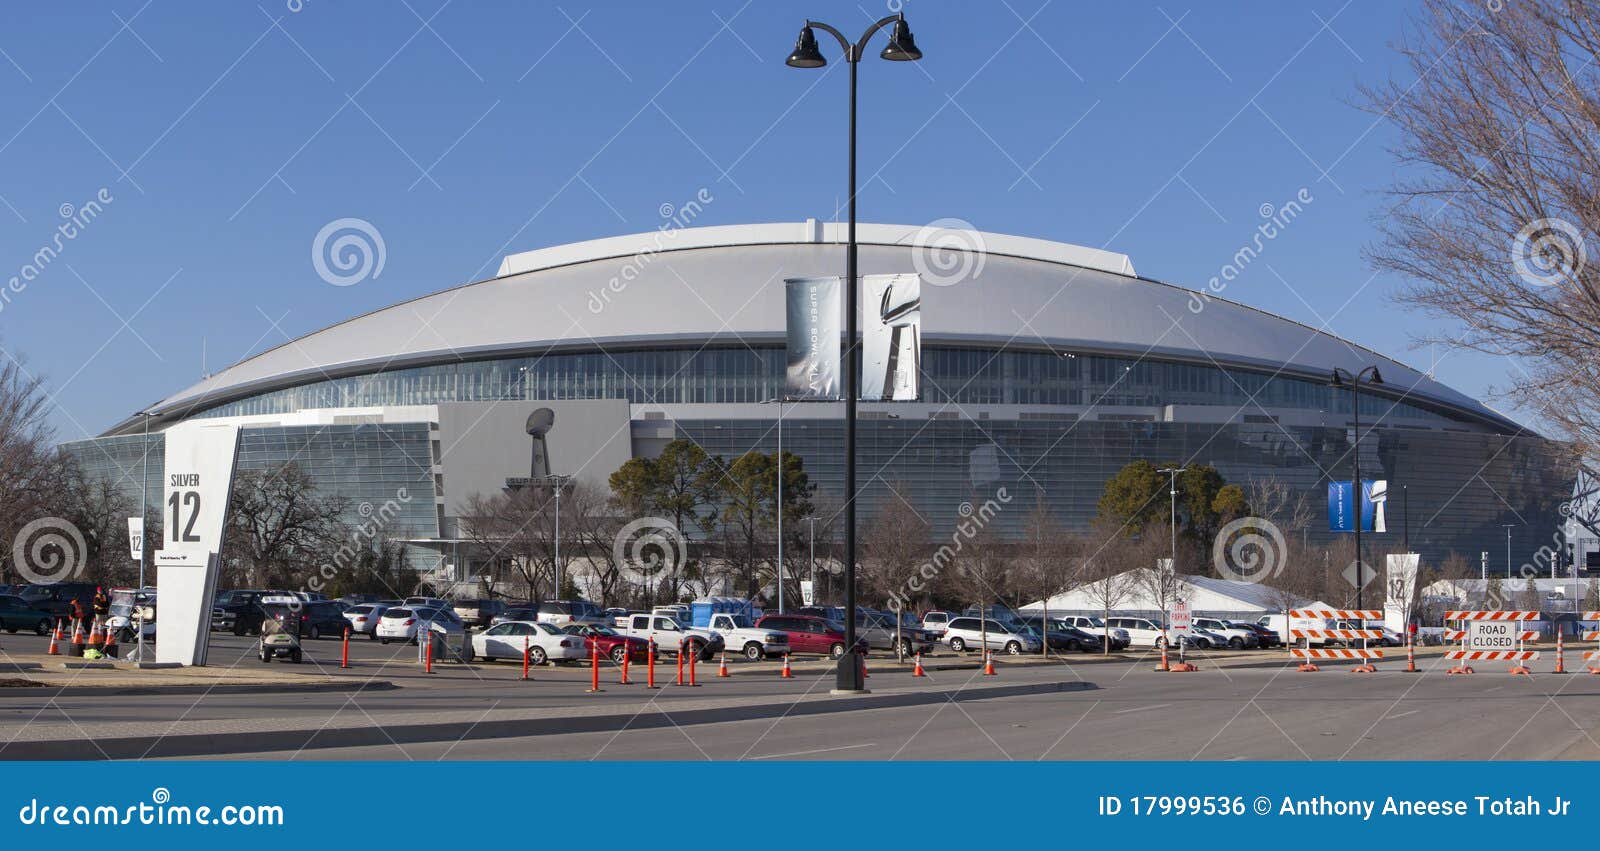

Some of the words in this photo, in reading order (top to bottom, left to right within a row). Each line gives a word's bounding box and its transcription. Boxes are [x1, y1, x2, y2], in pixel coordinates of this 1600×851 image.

[810, 286, 818, 322] SUPER
[810, 328, 819, 358] BOWL
[808, 361, 820, 391] XLV
[171, 474, 200, 487] SILVER
[168, 491, 201, 542] 12
[132, 535, 142, 552] 12
[1389, 579, 1405, 599] 12
[1479, 626, 1507, 635] ROAD
[1473, 637, 1512, 647] CLOSED
